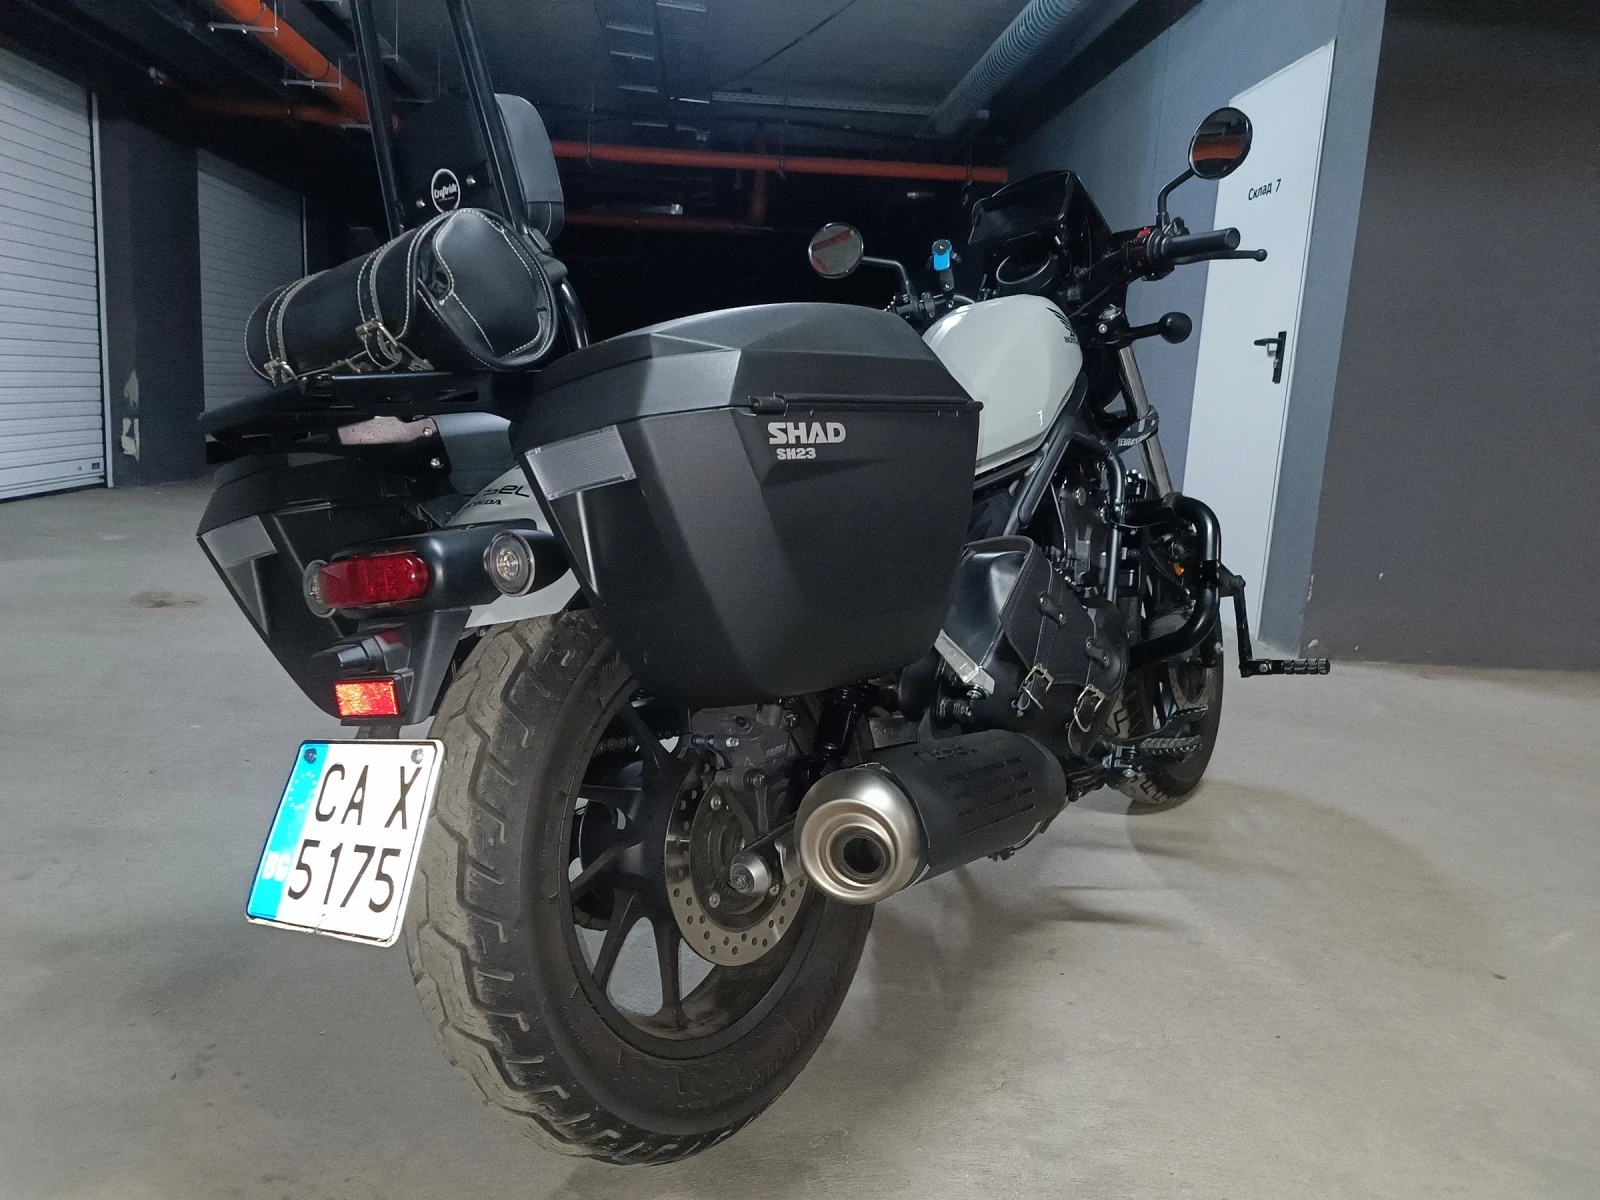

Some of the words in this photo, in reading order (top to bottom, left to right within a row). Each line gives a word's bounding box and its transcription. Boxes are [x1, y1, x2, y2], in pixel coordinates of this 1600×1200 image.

[1248, 182, 1272, 201] Склад
[1275, 178, 1282, 192] 7
[767, 422, 846, 444] SHAD
[776, 447, 816, 460] SH23
[315, 763, 369, 826] CA
[384, 766, 422, 830] X
[288, 839, 401, 913] 5175
